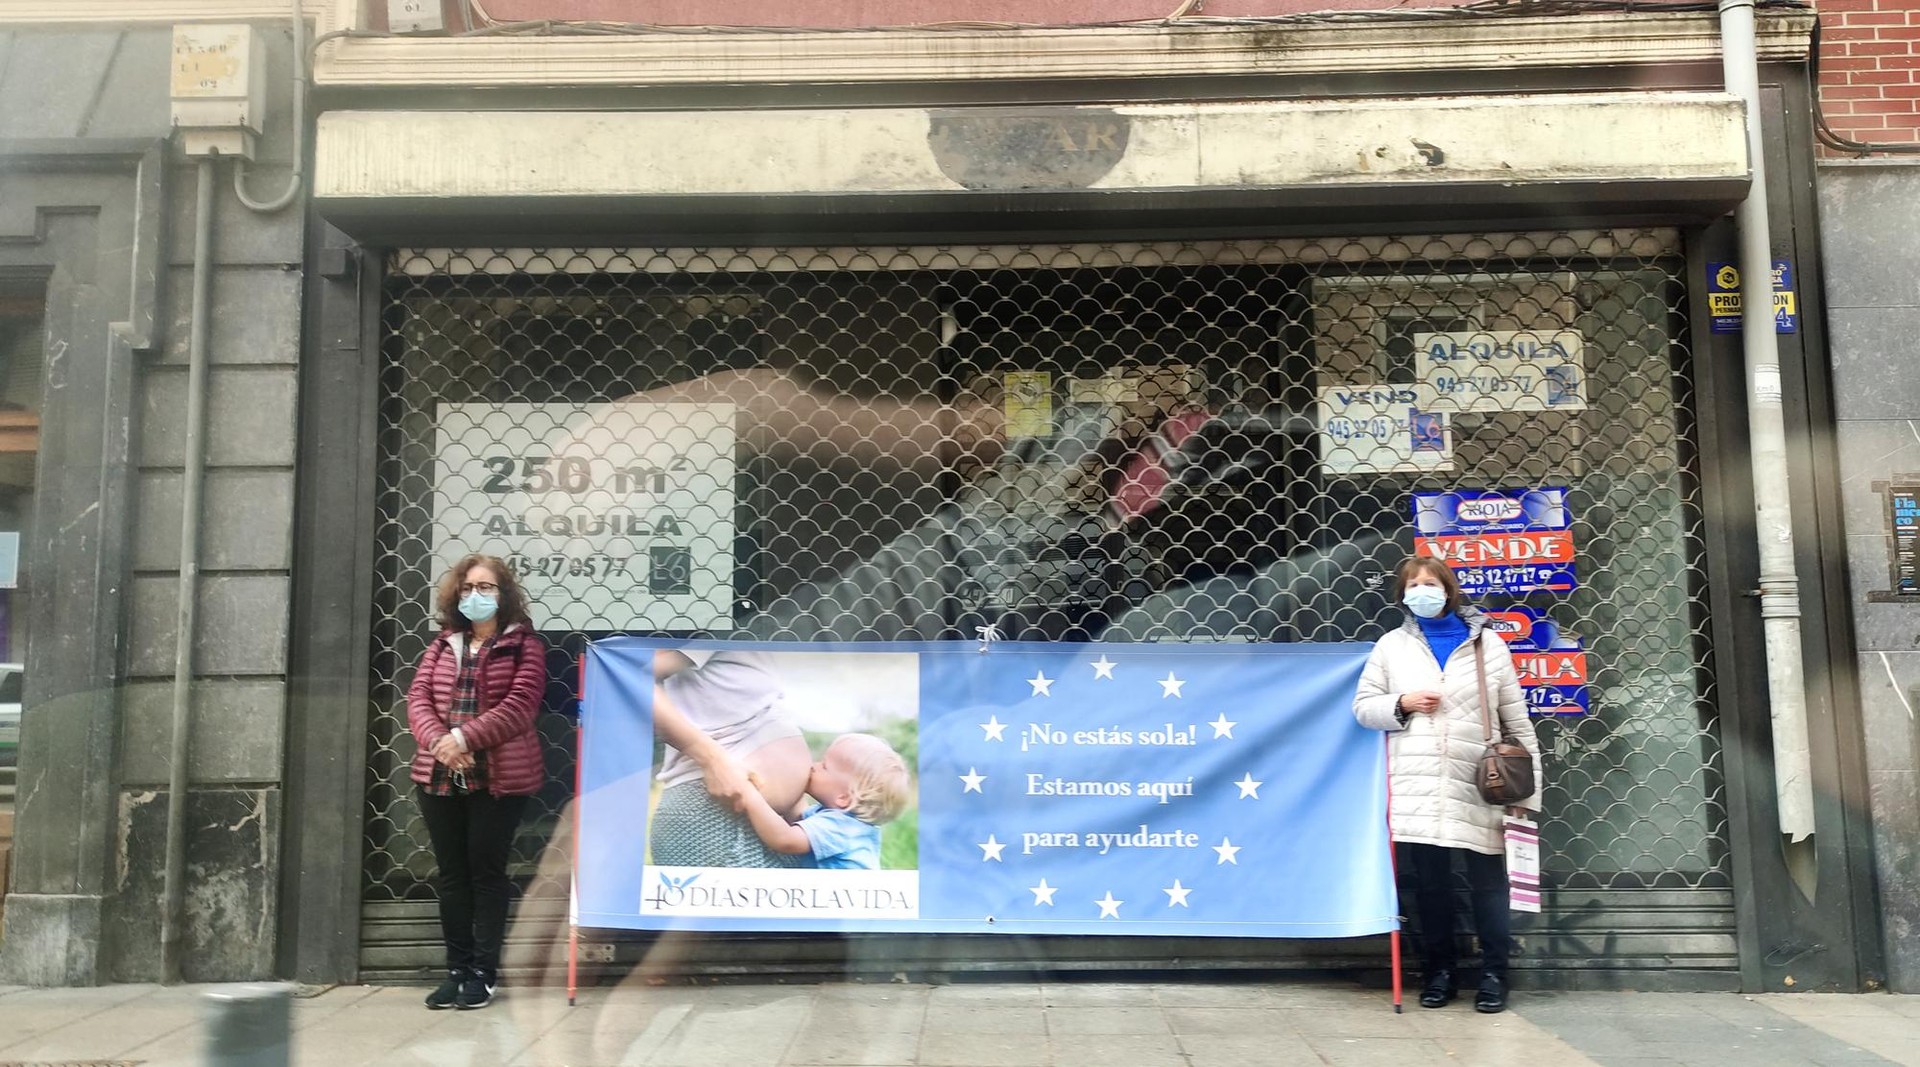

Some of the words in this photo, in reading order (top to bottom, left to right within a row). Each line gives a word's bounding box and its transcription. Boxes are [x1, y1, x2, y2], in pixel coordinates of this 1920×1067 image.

[1428, 340, 1569, 362] ALQUILA
[1335, 389, 1418, 406] VEND
[1328, 419, 1350, 439] 945
[1371, 419, 1386, 438] 05
[482, 455, 592, 494] 250
[481, 514, 683, 537] ALQUILA
[1427, 536, 1561, 562] VENDE
[507, 556, 531, 577] 45
[537, 556, 565, 577] 27
[569, 556, 596, 577] 05
[1457, 570, 1485, 585] 945
[1485, 568, 1503, 584] 12
[1530, 688, 1547, 704] 17
[1021, 723, 1067, 751] ¡No
[1073, 725, 1133, 745] estás
[1138, 723, 1197, 745] sola!
[1026, 773, 1132, 796] Estamos
[1137, 776, 1194, 804] aquí
[1022, 831, 1079, 854] para
[1085, 825, 1199, 855] ayudarte
